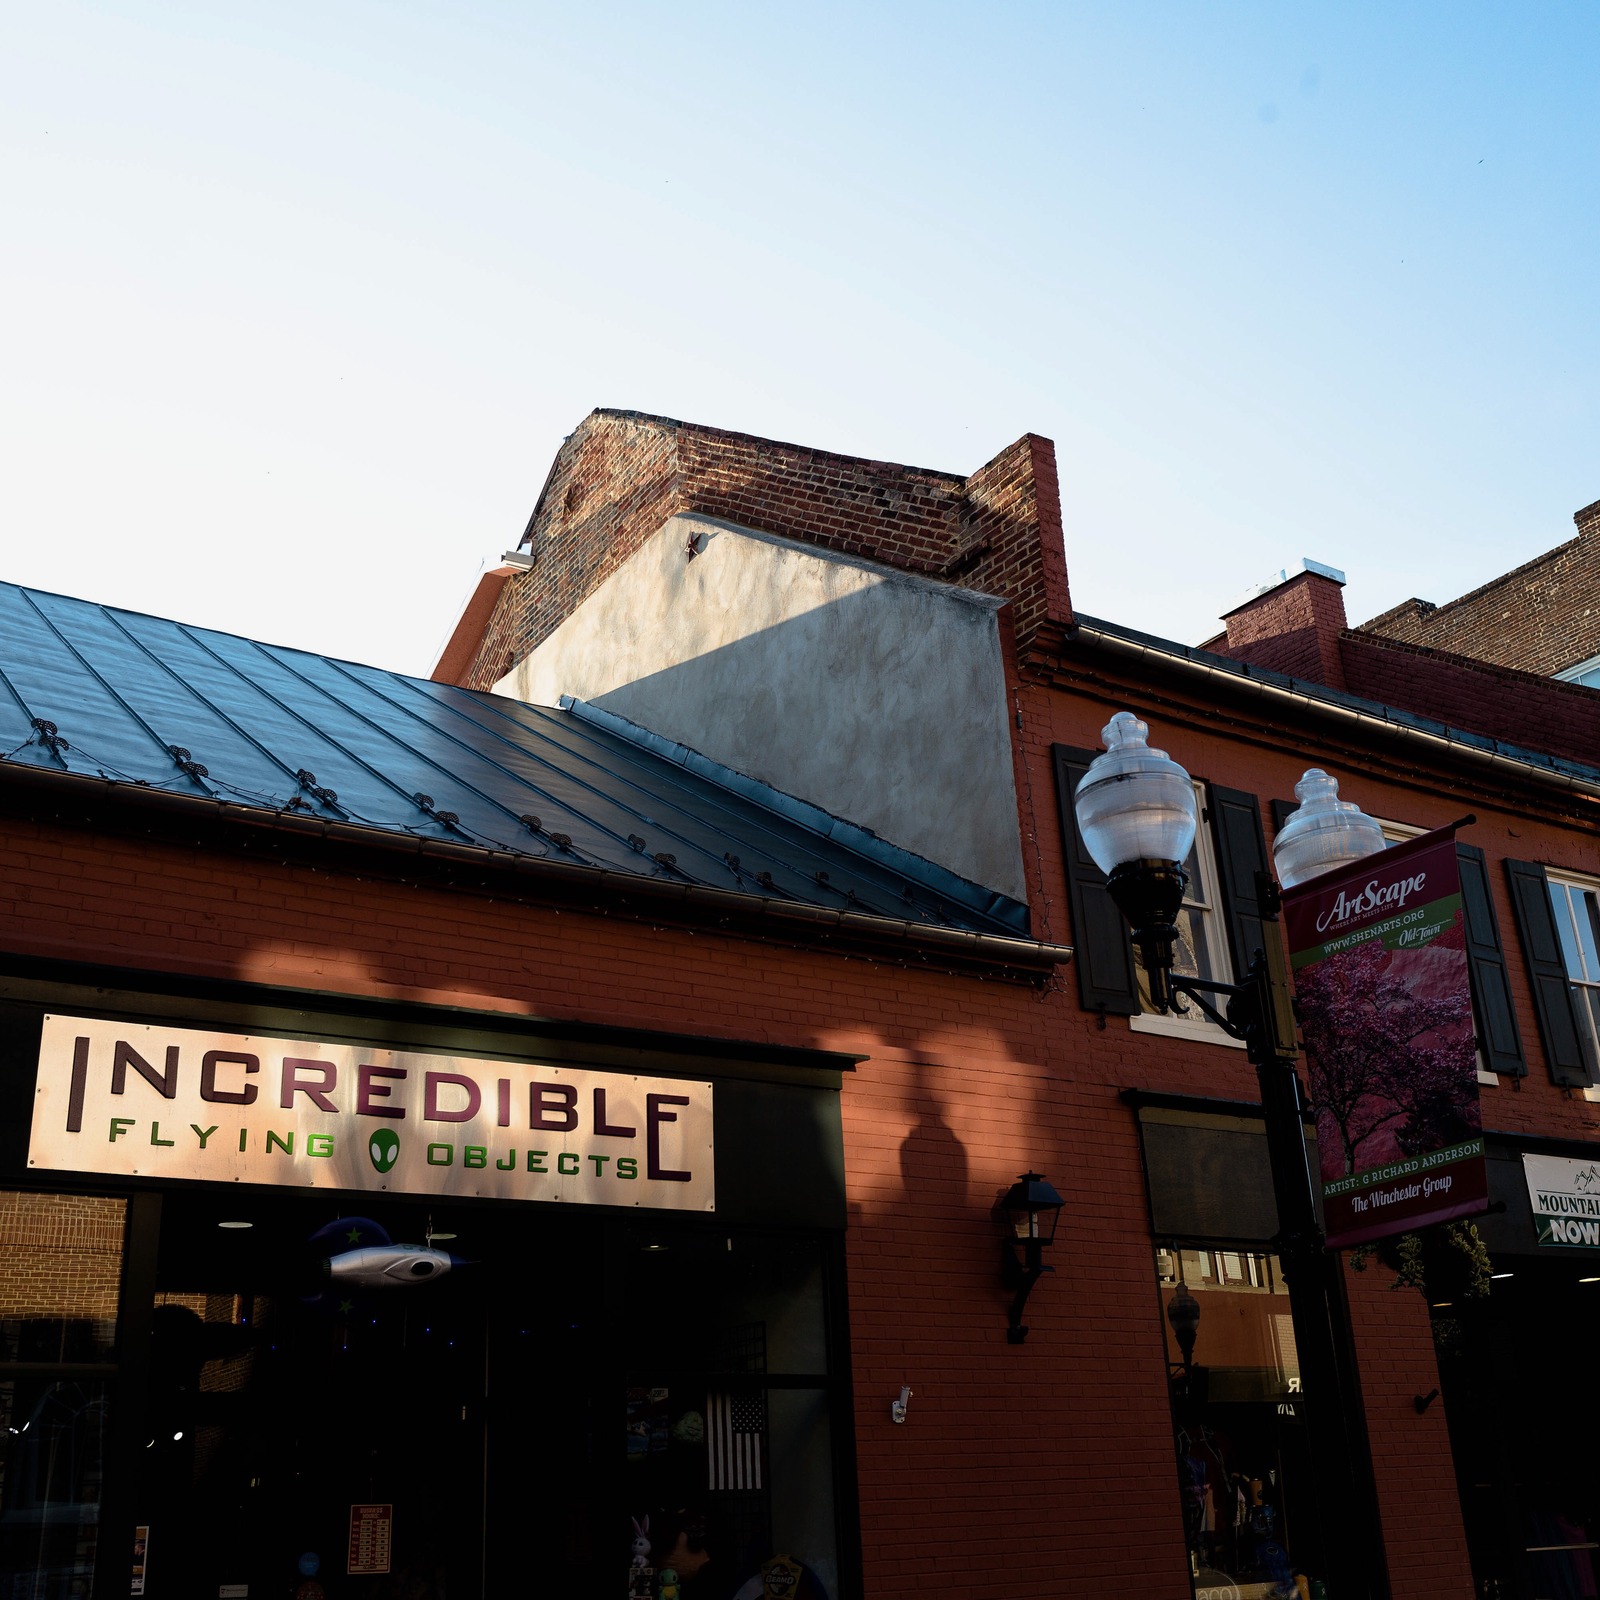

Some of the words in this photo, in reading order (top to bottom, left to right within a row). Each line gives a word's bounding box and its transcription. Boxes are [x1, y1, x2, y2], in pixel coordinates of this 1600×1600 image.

[1316, 872, 1426, 933] ArtScape
[1329, 919, 1351, 931] WHERE
[1350, 914, 1362, 924] ART
[1362, 907, 1381, 919] MEETS
[1381, 902, 1394, 911] LIFE
[1323, 909, 1425, 954] WWW.SHENARTS.ORG
[1399, 928, 1417, 946] Old
[1416, 924, 1441, 941] Town
[66, 1036, 692, 1182] INCREDIBLE
[109, 1117, 335, 1158] FLYING
[427, 1143, 639, 1180] OBJECTS
[1324, 1178, 1359, 1196] ARTIST:
[1363, 1174, 1370, 1185] G
[1372, 1160, 1419, 1181] RICHARD
[1422, 1142, 1481, 1168] ANDERSON
[1351, 1196, 1369, 1213] The
[1369, 1183, 1422, 1209] Winchester
[1423, 1175, 1453, 1198] Group
[1549, 1219, 1600, 1246] NOW
